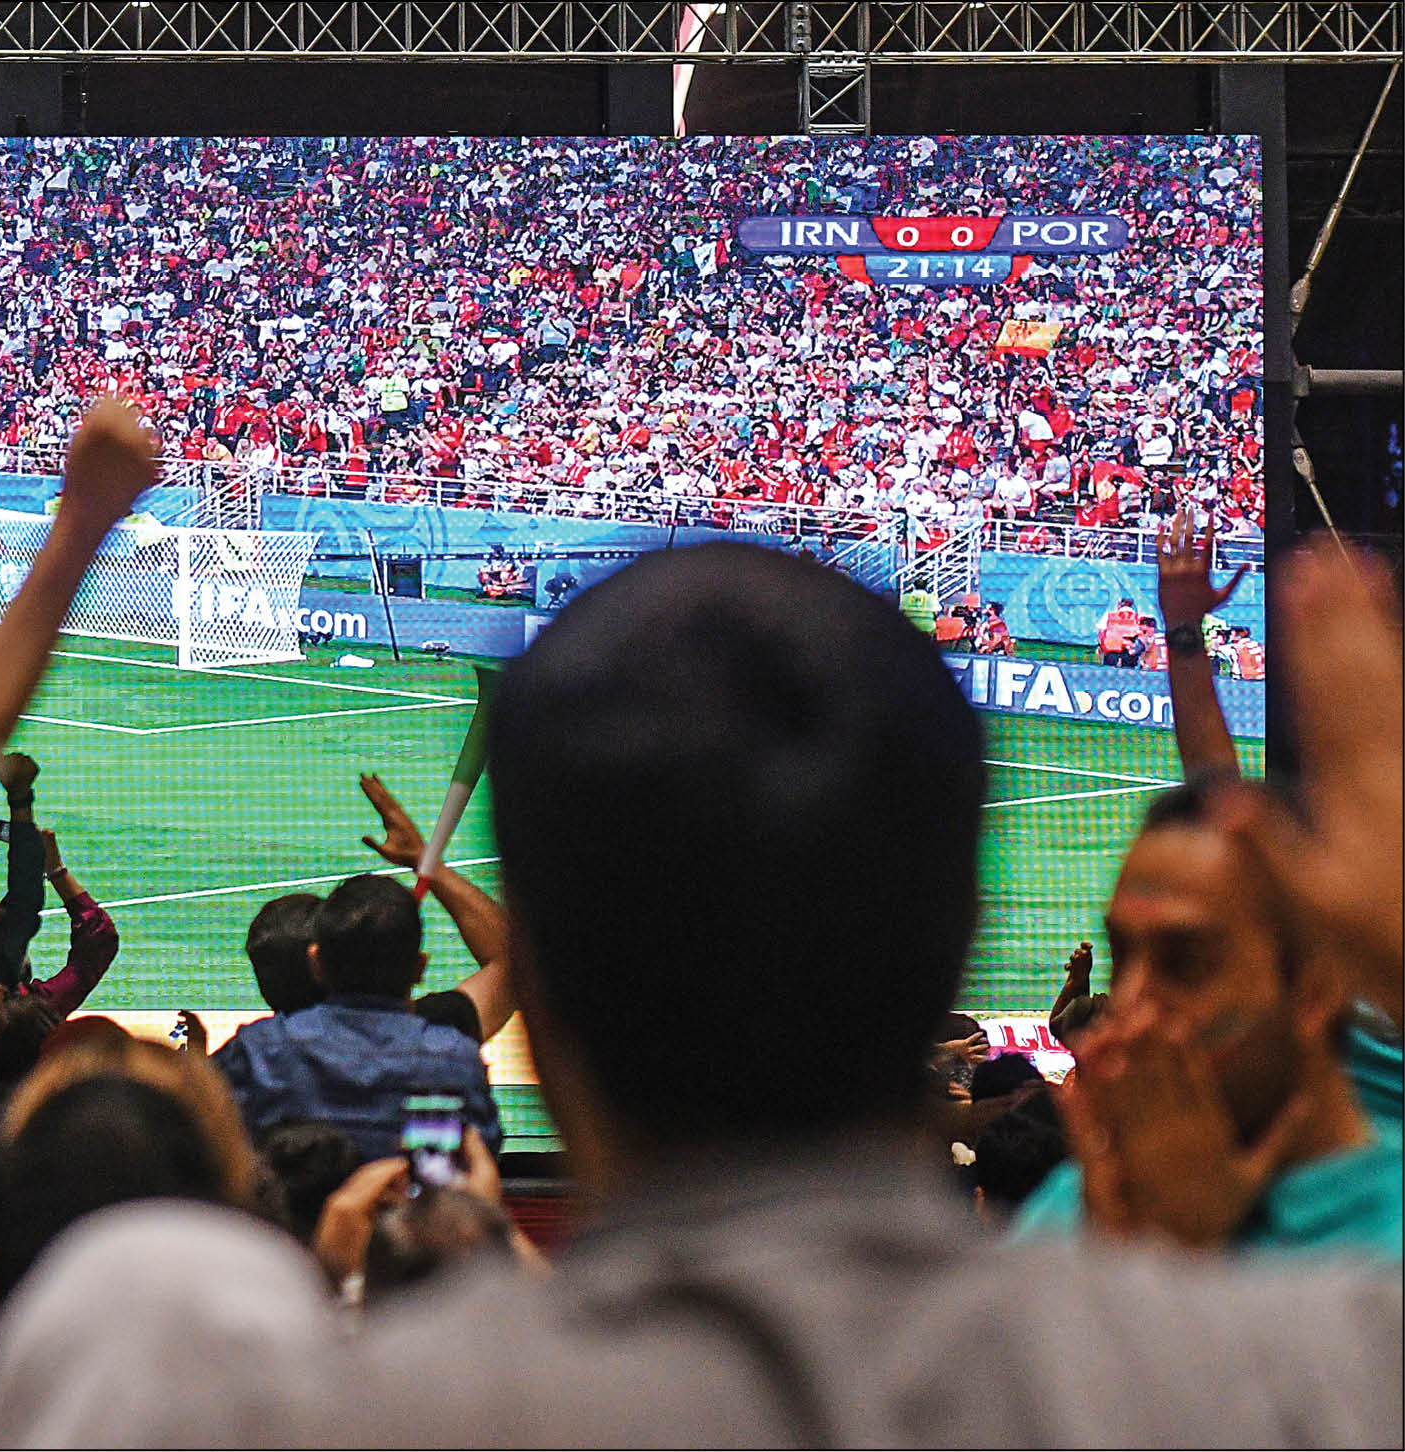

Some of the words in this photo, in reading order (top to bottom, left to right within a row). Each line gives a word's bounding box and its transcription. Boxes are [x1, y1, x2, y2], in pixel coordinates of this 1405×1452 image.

[780, 221, 859, 247] IRN
[896, 227, 920, 248] 0
[951, 227, 974, 248] 0
[1012, 221, 1108, 247] POR
[887, 258, 994, 279] 21:14
